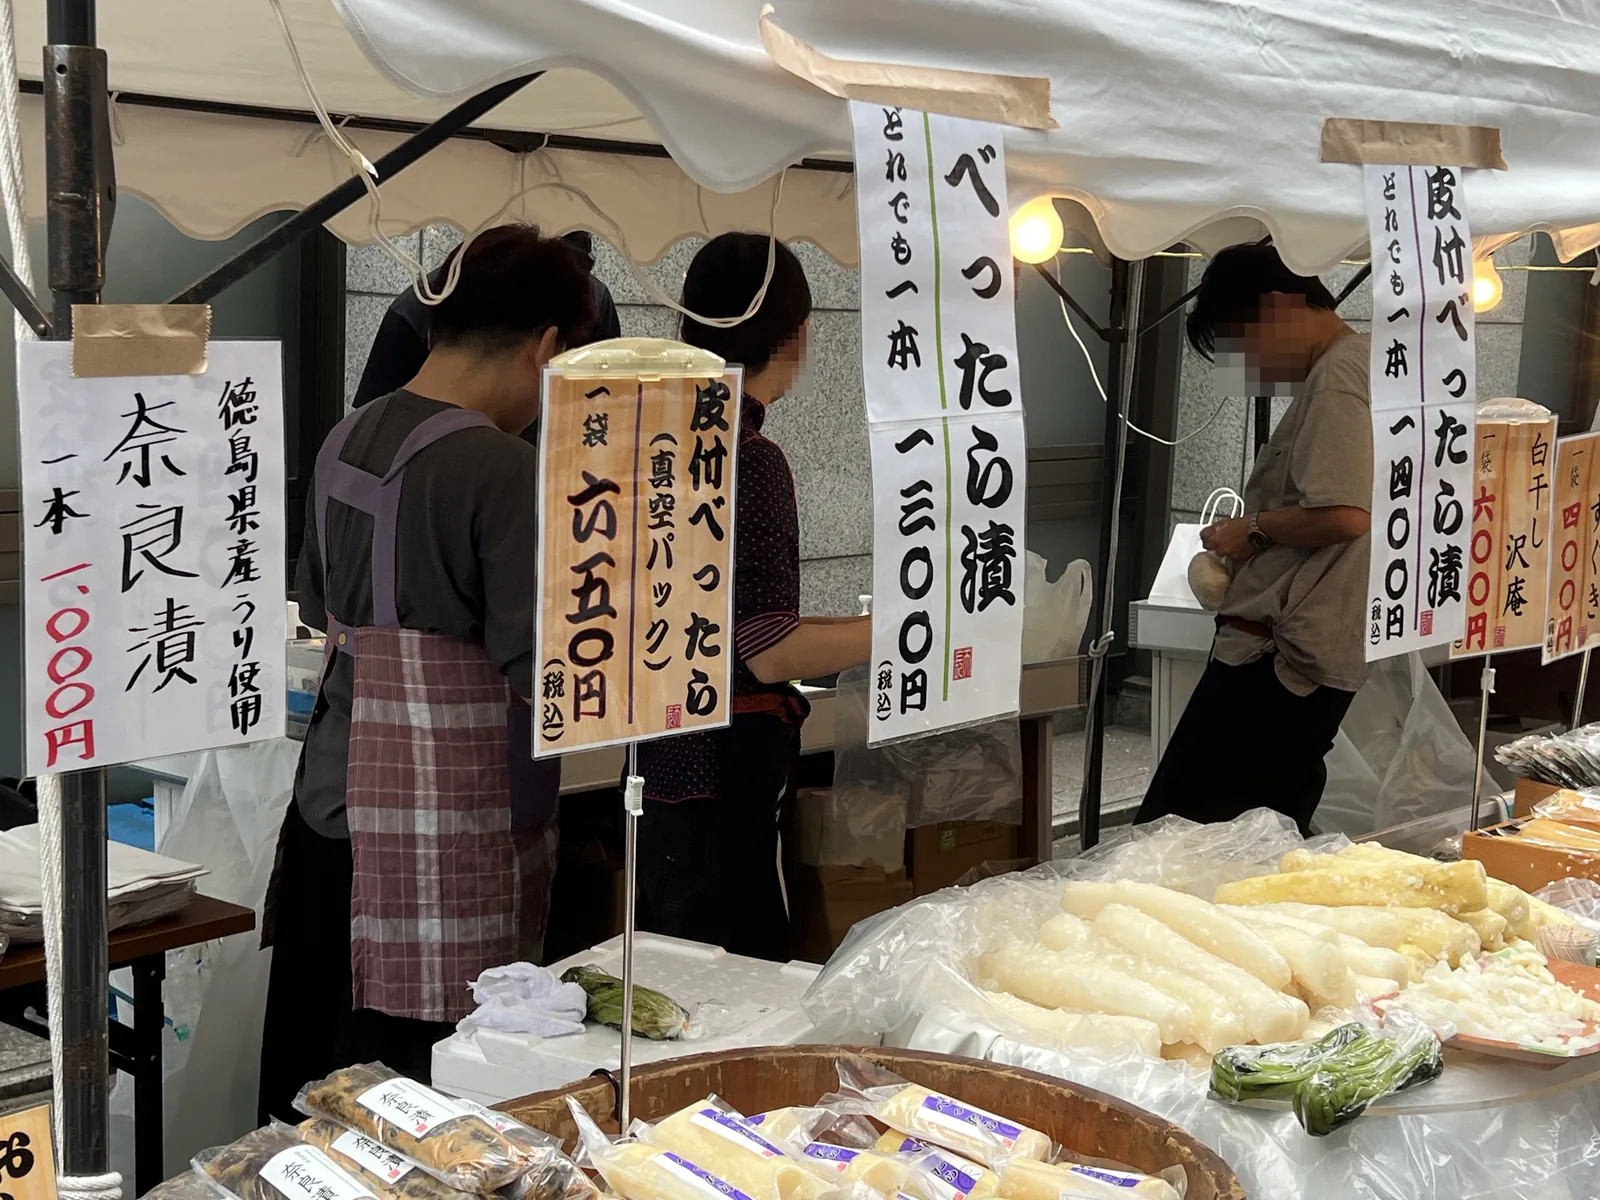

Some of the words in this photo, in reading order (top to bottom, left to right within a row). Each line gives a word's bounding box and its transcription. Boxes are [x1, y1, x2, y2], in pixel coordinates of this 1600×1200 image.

[883, 106, 921, 371] どれでも一本
[1383, 172, 1410, 379] どれでも一本
[33, 453, 91, 534] 一本
[582, 385, 611, 447] 一袋
[944, 144, 1017, 614] べったら漬
[1424, 165, 1470, 609] 皮付べったら漬
[1528, 432, 1549, 549] 白干し
[103, 392, 205, 694] 奈良漬
[217, 376, 262, 736] 徳島県産うり使用
[642, 432, 677, 671] （真空パック）
[683, 377, 731, 717] 皮付べったら
[1503, 534, 1530, 617] 沢庵
[378, 1091, 435, 1125] 奈良漬
